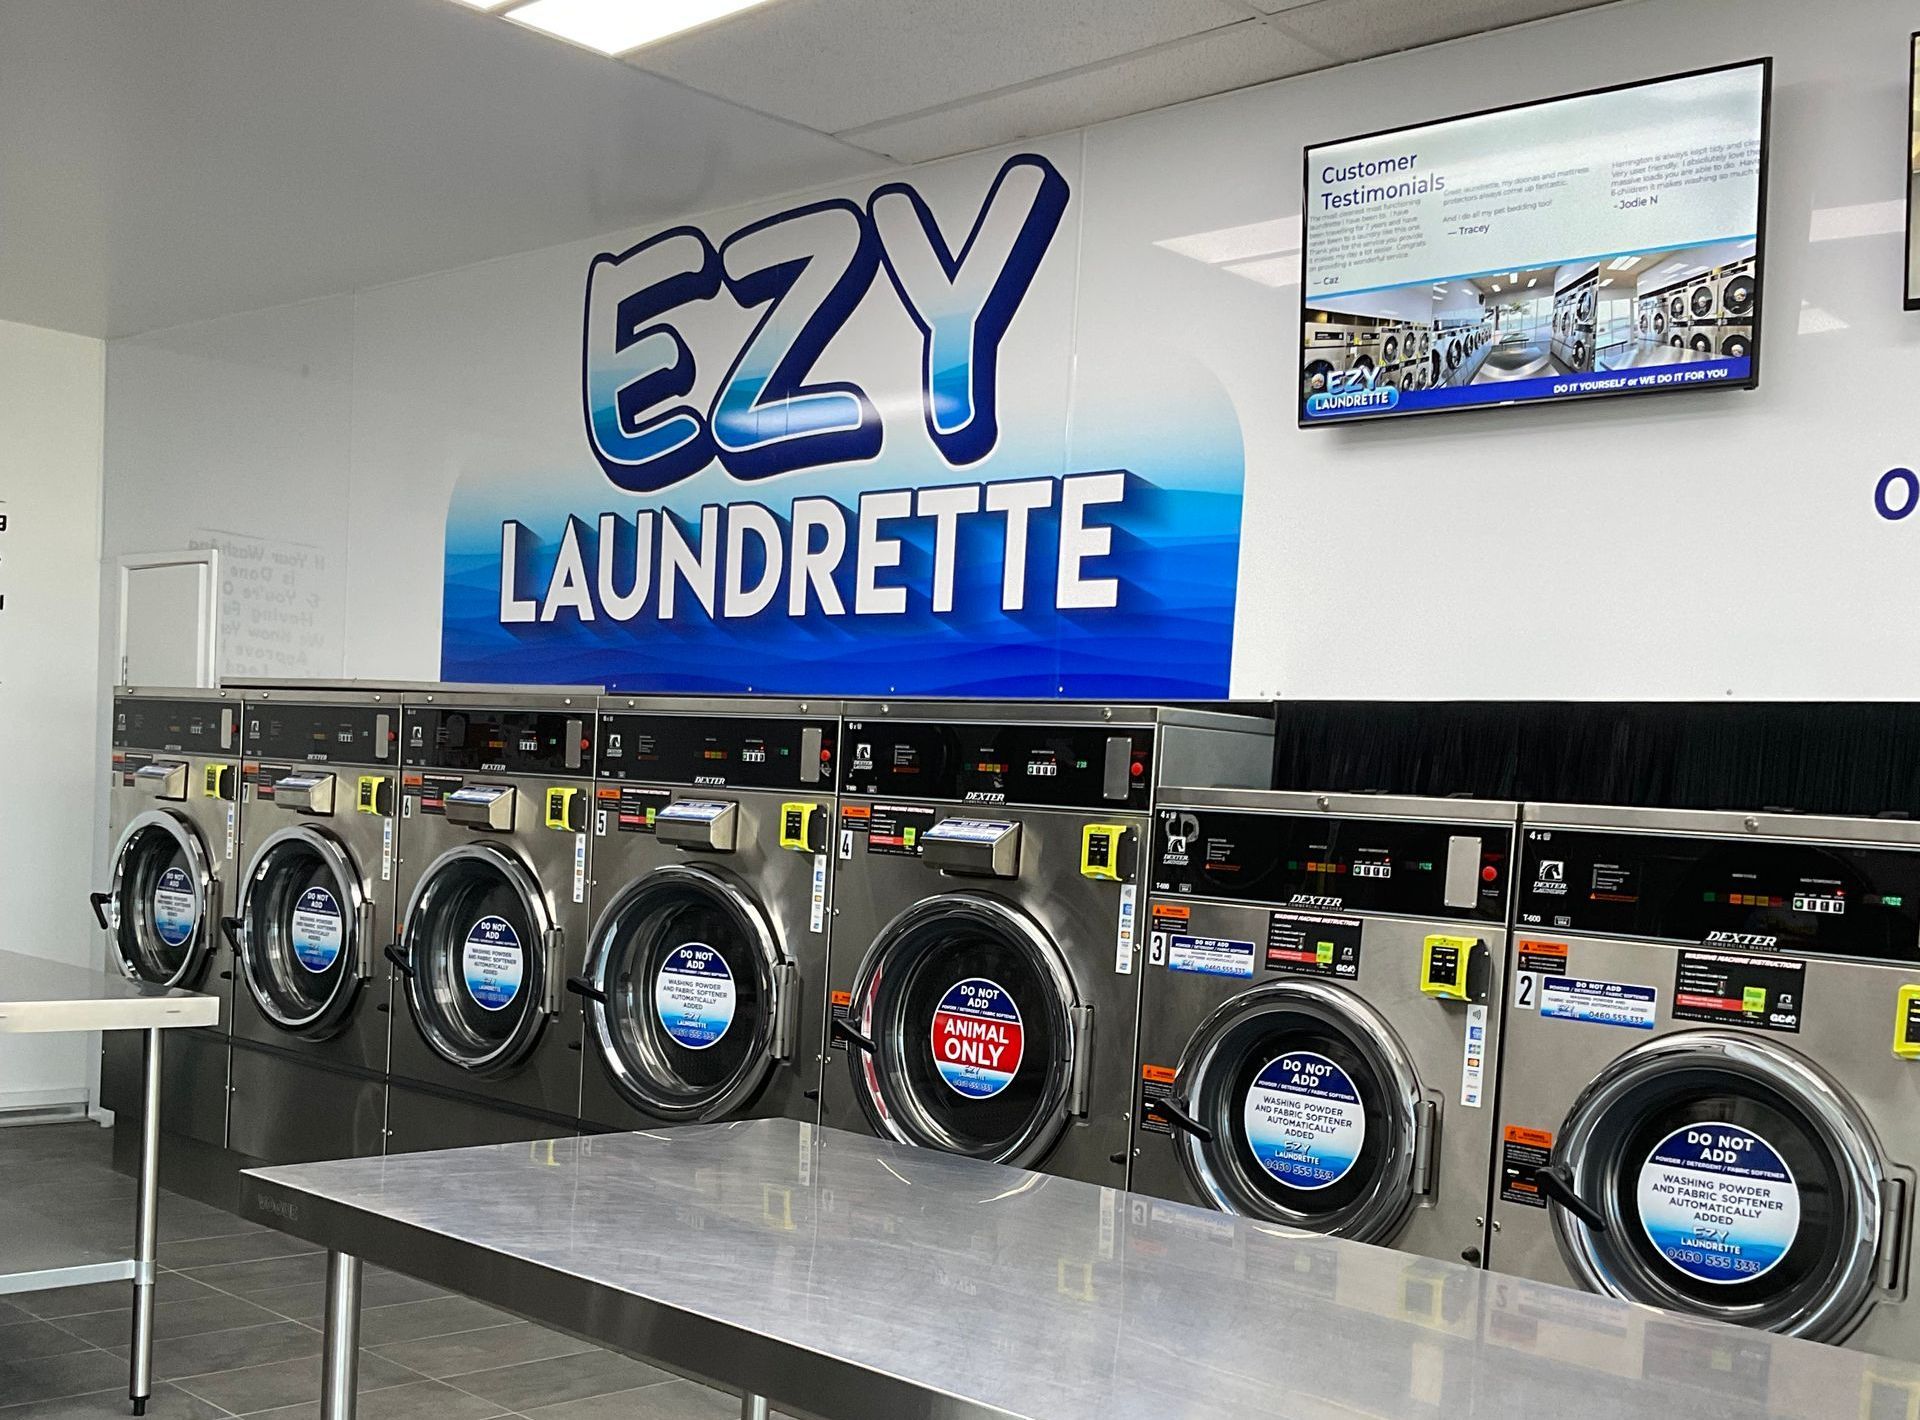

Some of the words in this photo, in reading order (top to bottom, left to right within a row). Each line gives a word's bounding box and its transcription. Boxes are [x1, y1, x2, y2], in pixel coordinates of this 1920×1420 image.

[1322, 154, 1418, 184] Customer
[1684, 174, 1717, 185] washing
[1321, 173, 1445, 210] Testimonials
[1619, 197, 1647, 210] Jodie
[1650, 195, 1658, 205] N
[1443, 214, 1457, 223] And
[1507, 202, 1537, 213] bedding
[1459, 224, 1490, 236] Tracey
[1324, 276, 1339, 285] Caz
[582, 154, 1070, 494] EZY
[1327, 365, 1382, 395] EZY
[1554, 384, 1568, 394] DO
[1570, 383, 1578, 392] IT
[1580, 378, 1626, 391] YOURSELF
[1628, 379, 1638, 387] or
[1639, 375, 1656, 385] WE
[1657, 374, 1673, 383] DO
[1675, 373, 1683, 382] IT
[1685, 371, 1705, 381] FOR
[1707, 368, 1728, 378] YOU
[1315, 392, 1388, 410] LAUNDRETTE
[501, 472, 1127, 624] LAUNDRETTE
[481, 763, 506, 771] DEXTER
[694, 776, 726, 785] DEXTER
[966, 792, 1005, 801] DEXTER
[404, 797, 410, 817] 6
[598, 812, 605, 833] 5
[1529, 831, 1536, 840] 4
[843, 833, 849, 856] 4
[1533, 881, 1568, 889] DEXTER
[1290, 894, 1342, 907] DEXTER
[481, 922, 490, 930] DO
[492, 923, 507, 931] NOT
[1703, 941, 1746, 949] COMMERCIAL
[1706, 931, 1777, 947] DEXTER
[680, 950, 693, 959] DO
[695, 952, 714, 961] NOT
[1153, 936, 1162, 961] 3
[686, 961, 705, 970] ADD
[668, 979, 694, 987] WASHING
[1519, 976, 1532, 1006] 2
[671, 994, 717, 1004] AUTOMATICALLY
[697, 990, 728, 998] SOFTENER
[960, 986, 975, 996] DO
[978, 987, 999, 1000] NOT
[967, 998, 989, 1009] ADD
[1589, 1011, 1611, 1019] 0460
[1612, 1014, 1627, 1022] 555
[1629, 1016, 1644, 1024] 333
[944, 1018, 1009, 1044] ANIMAL
[944, 1037, 1004, 1067] ONLY
[1282, 1060, 1302, 1072] DO
[1305, 1064, 1333, 1077] NOT
[1291, 1074, 1319, 1087] ADD
[1263, 1096, 1301, 1109] WASHING
[1304, 1103, 1343, 1116] POWDER
[1255, 1105, 1272, 1114] AND
[1273, 1108, 1302, 1119] FABRIC
[1305, 1113, 1352, 1128] SOFTENER
[1267, 1115, 1336, 1134] AUTOMATICALLY
[1284, 1129, 1314, 1140] ADDED
[1687, 1131, 1712, 1146] DO
[1718, 1135, 1755, 1152] NOT
[1284, 1142, 1311, 1155] EZY
[1700, 1148, 1737, 1164] ADD
[1274, 1150, 1320, 1165] LAUNDRETTE
[1292, 1165, 1312, 1177] 555
[1314, 1169, 1334, 1180] 333
[1655, 1155, 1681, 1166] POWDER
[1686, 1160, 1722, 1171] DETERGENT
[1727, 1166, 1750, 1175] FABRIC
[1751, 1169, 1785, 1179] SOFTENER
[1663, 1174, 1714, 1190] WASHING
[1718, 1183, 1771, 1198] POWDER
[1652, 1183, 1675, 1194] AND
[1678, 1187, 1717, 1201] FABRIC
[1722, 1194, 1784, 1211] SOFTENER
[1668, 1197, 1762, 1219] AUTOMATICALLY
[1694, 1212, 1734, 1225] ADDED
[1692, 1225, 1729, 1241] EZY
[1680, 1237, 1741, 1255] LAUNDRETTE
[1666, 1247, 1702, 1262] 0460
[1706, 1254, 1730, 1267] 555
[1734, 1259, 1760, 1273] 333
